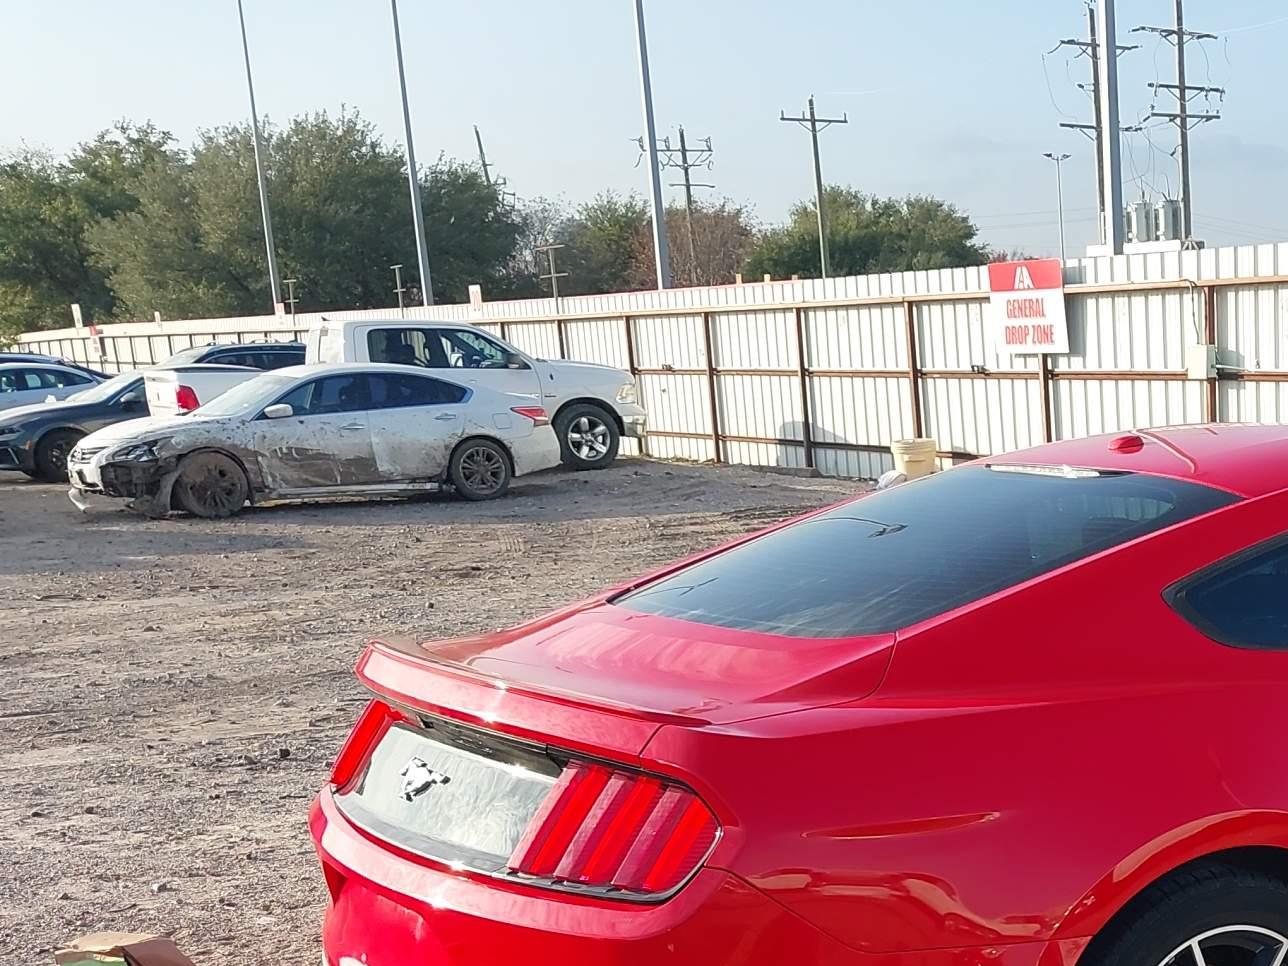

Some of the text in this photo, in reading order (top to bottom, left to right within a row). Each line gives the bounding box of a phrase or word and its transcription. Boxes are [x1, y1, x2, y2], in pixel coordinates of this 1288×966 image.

[1006, 297, 1047, 319] GENERAL
[1005, 323, 1055, 345] DROP ZONE
